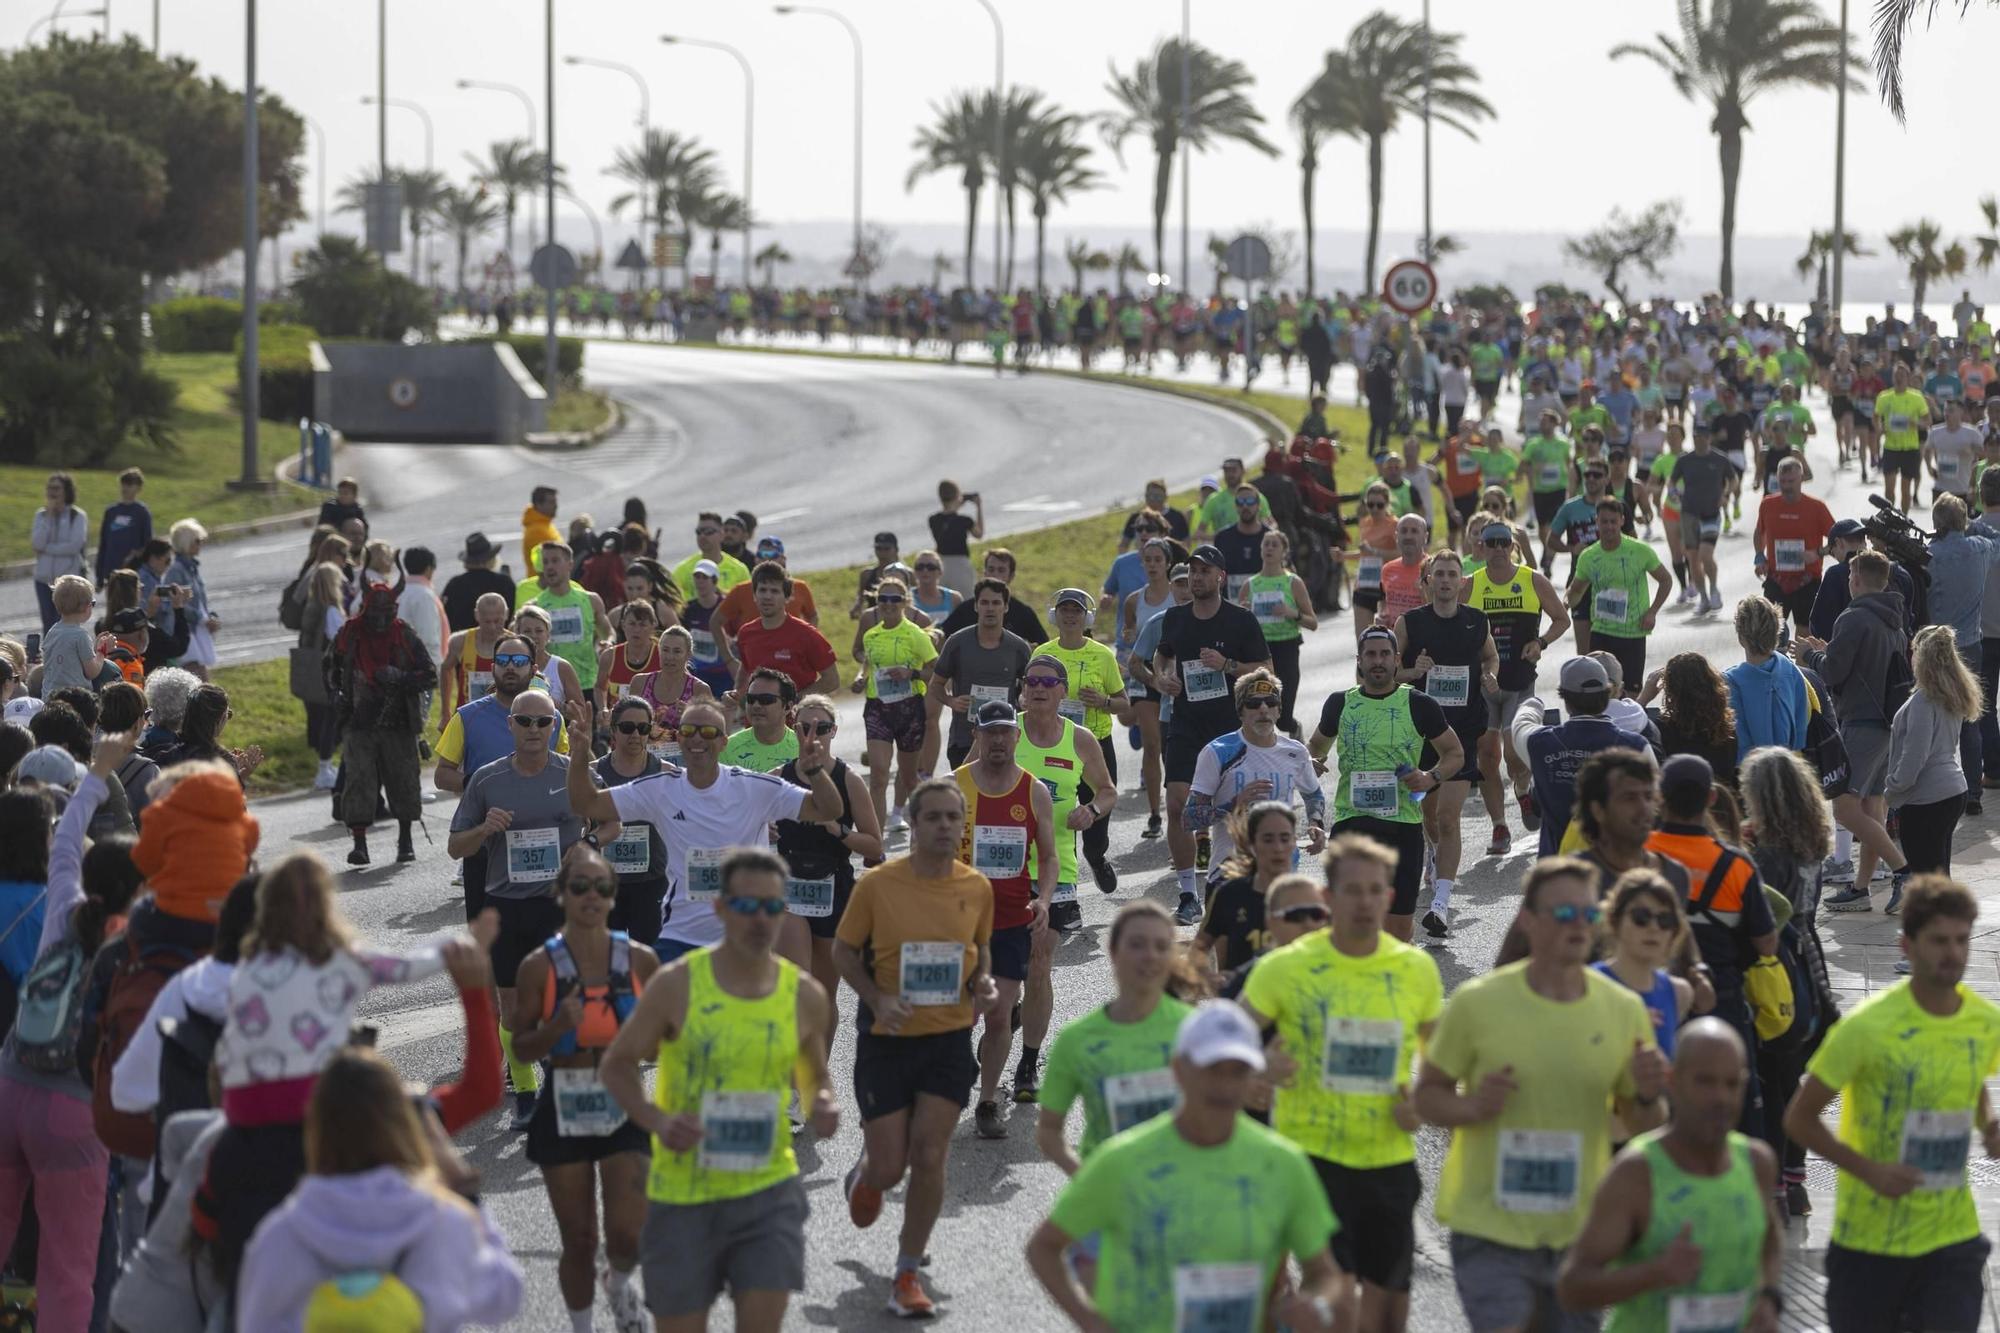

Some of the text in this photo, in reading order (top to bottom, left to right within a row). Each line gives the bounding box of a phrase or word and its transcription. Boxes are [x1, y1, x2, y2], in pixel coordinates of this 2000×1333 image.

[1395, 276, 1428, 299] 60
[1485, 597, 1521, 609] TOTAL TEAM
[1195, 673, 1214, 687] 367
[1437, 680, 1461, 692] 1206
[1544, 749, 1592, 764] QUIKSI
[1365, 789, 1385, 802] 560
[522, 848, 546, 864] 357
[615, 843, 637, 857] 634
[989, 845, 1013, 860] 996
[701, 867, 720, 884] 56
[792, 883, 823, 899] 1131
[915, 966, 950, 983] 1261
